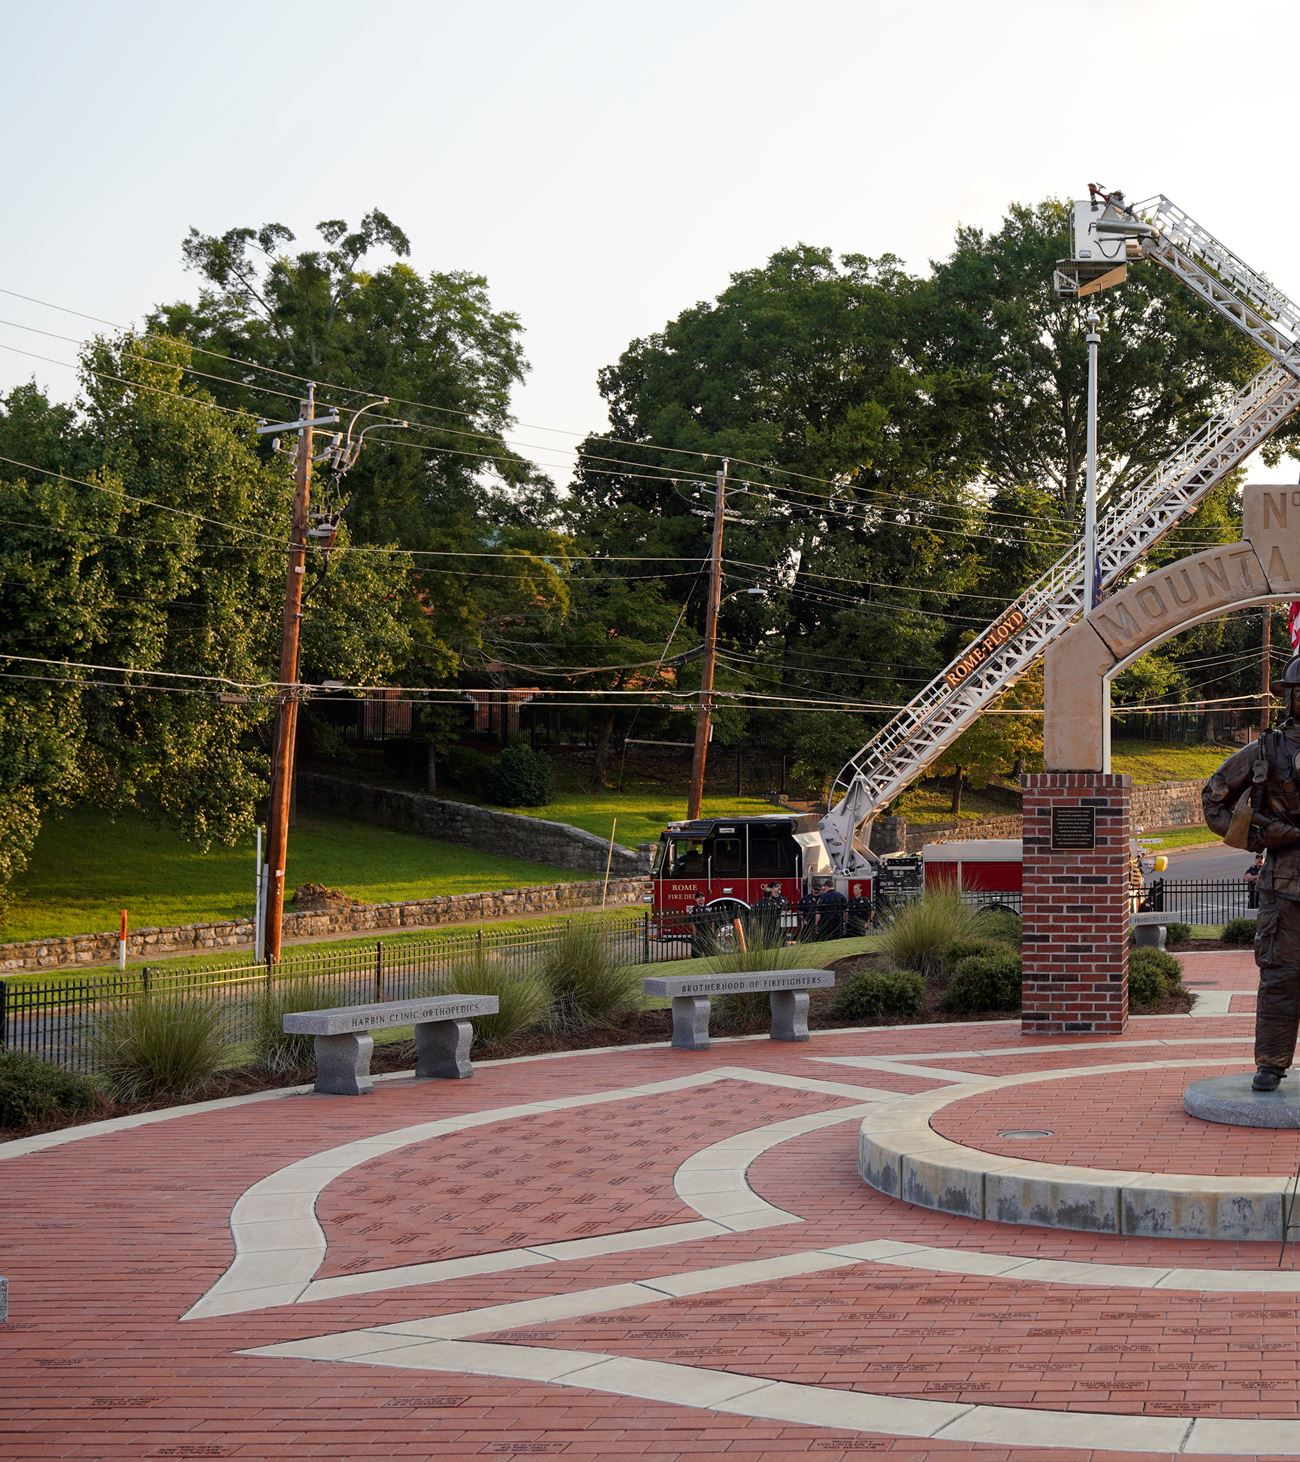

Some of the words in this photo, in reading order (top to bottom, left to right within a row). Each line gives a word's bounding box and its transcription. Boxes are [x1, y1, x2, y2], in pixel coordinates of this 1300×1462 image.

[946, 610, 1024, 687] ROME-FLOYD
[681, 982, 746, 993] BROTHERHOOD
[763, 976, 822, 988] FIREFIGHTERS
[352, 1014, 386, 1027] HARBIN
[389, 1010, 418, 1022] CLINIC
[422, 1003, 480, 1018] ORTHOPEDICS
